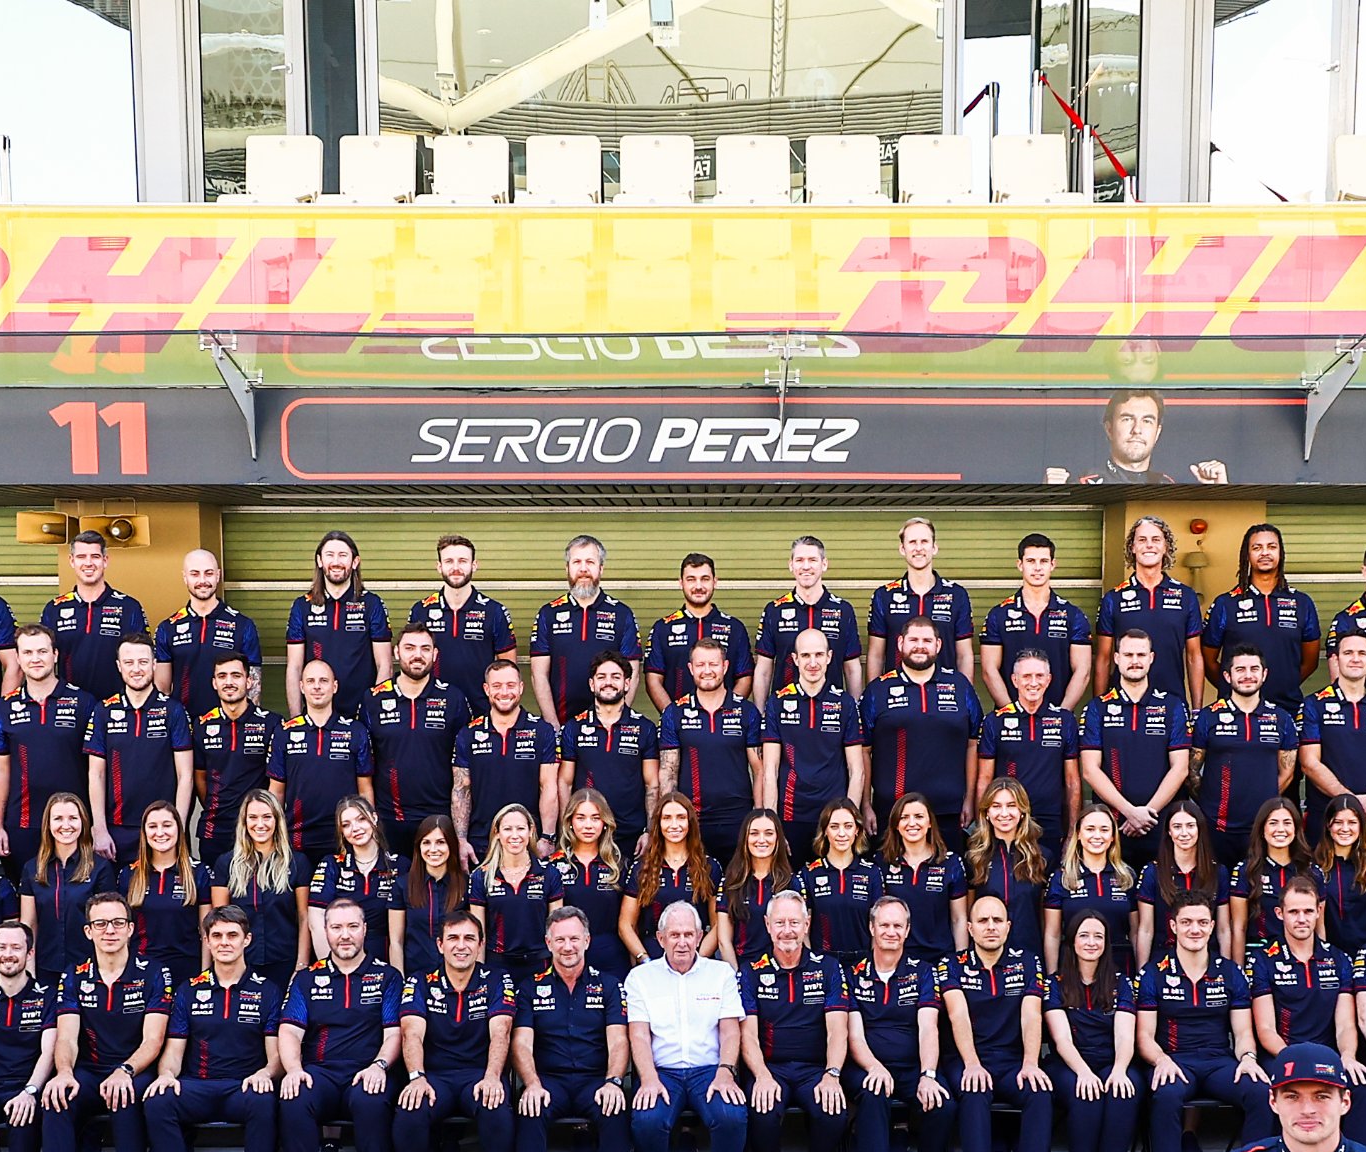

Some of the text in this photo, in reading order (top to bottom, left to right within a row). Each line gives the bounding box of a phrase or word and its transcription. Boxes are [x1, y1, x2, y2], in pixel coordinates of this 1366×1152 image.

[49, 402, 148, 475] 11
[410, 416, 860, 464] SERGIO PEREZ
